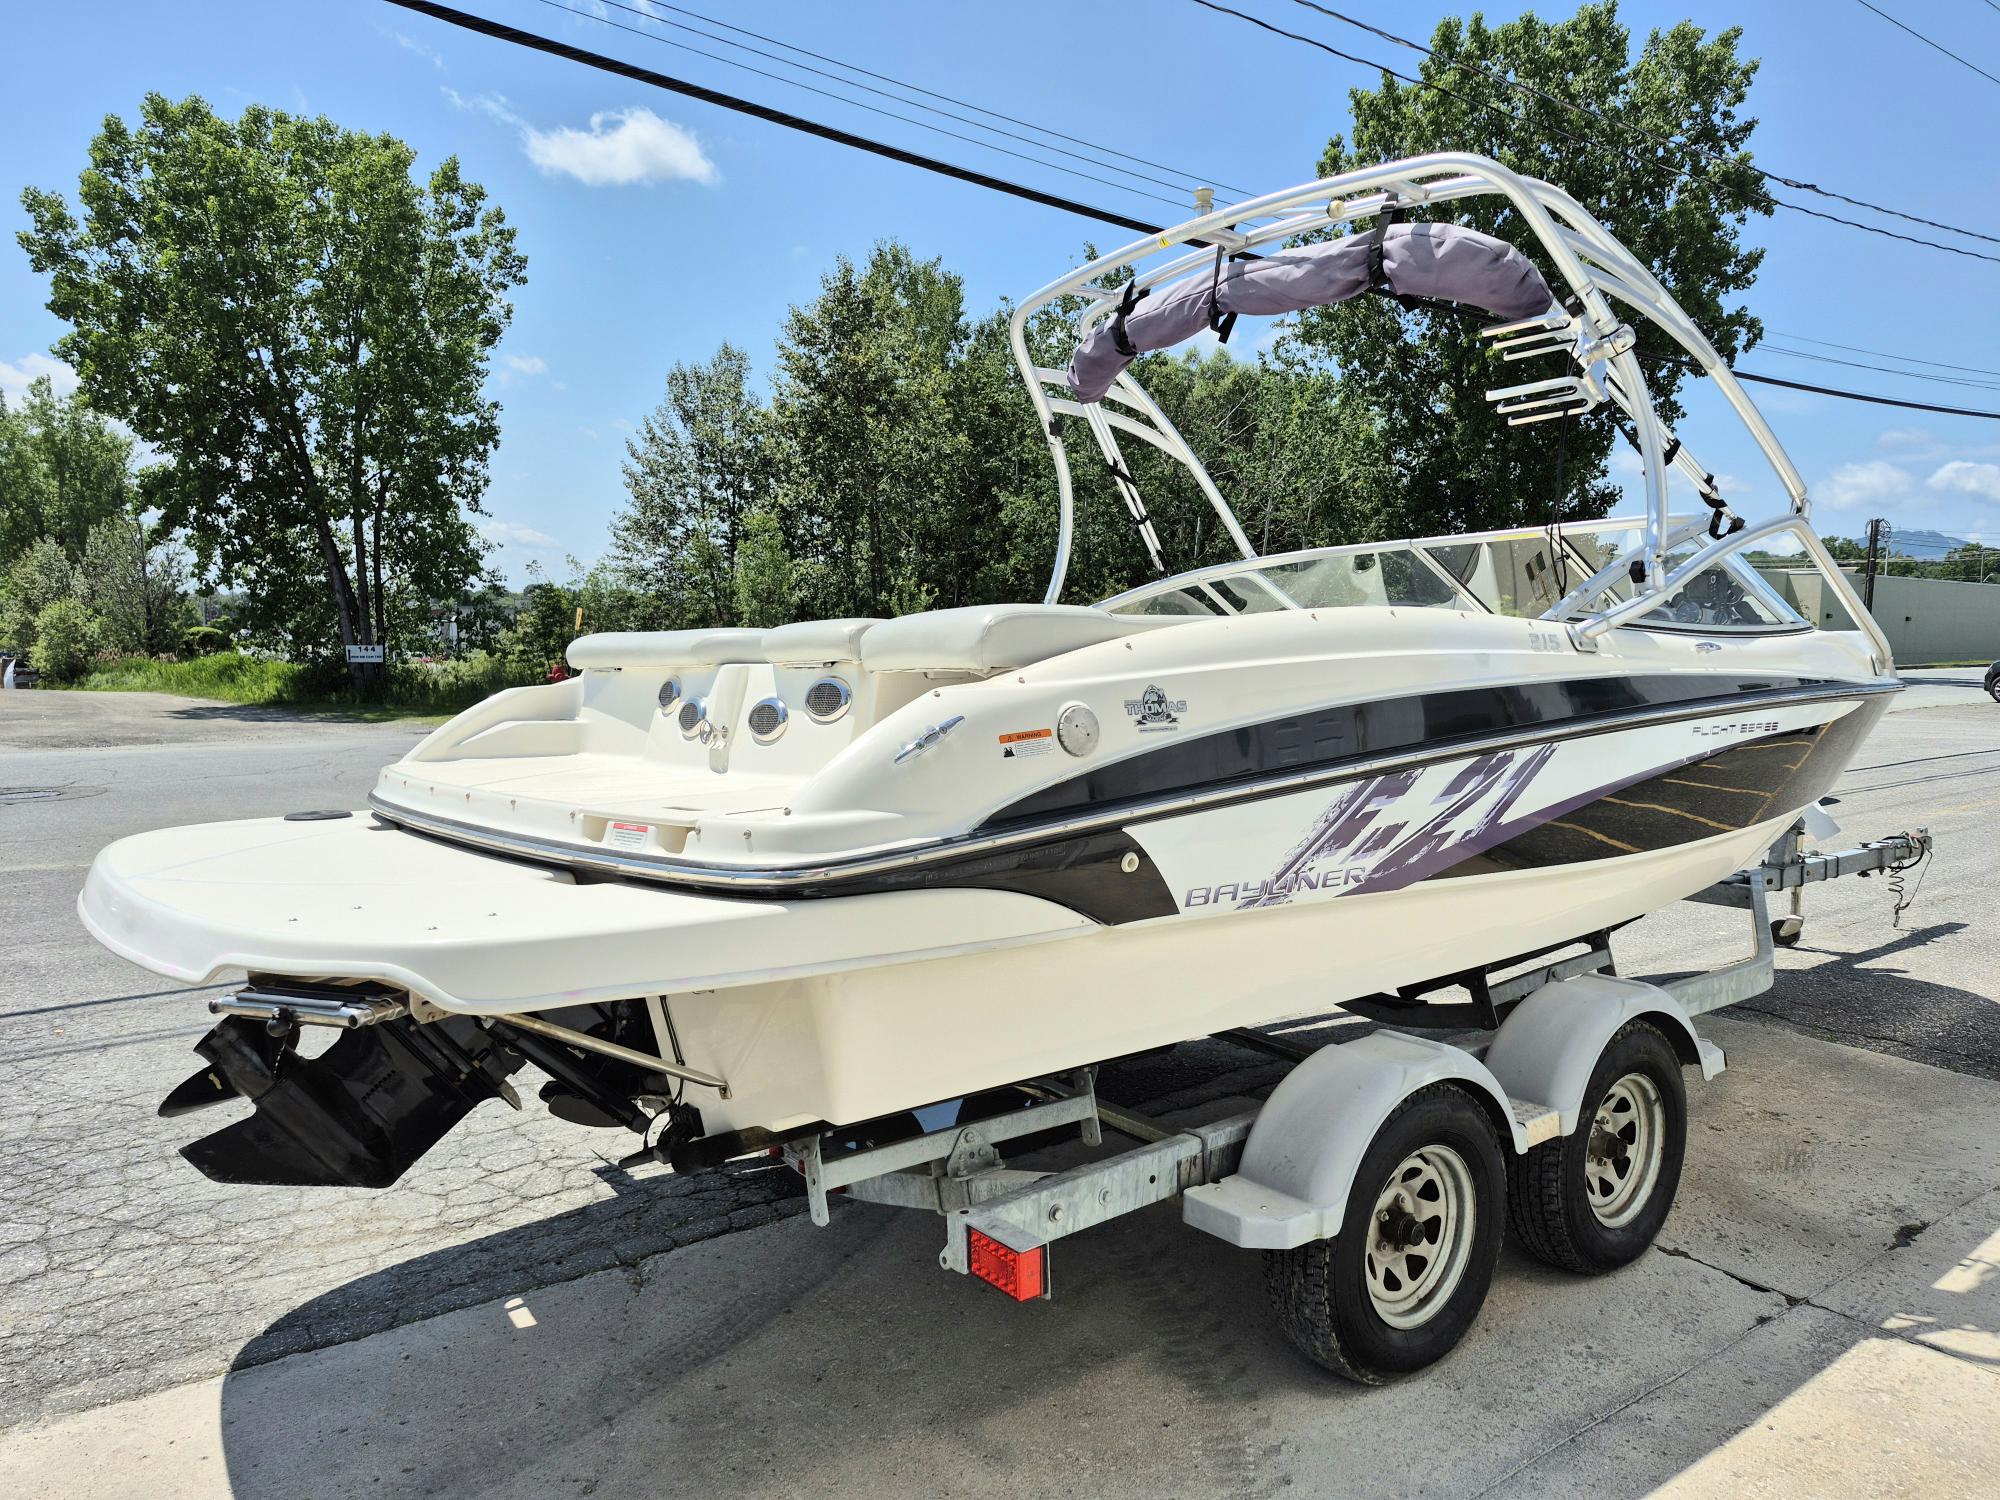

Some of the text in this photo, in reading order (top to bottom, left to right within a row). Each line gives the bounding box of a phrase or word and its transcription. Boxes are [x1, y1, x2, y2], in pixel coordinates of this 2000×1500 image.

[1529, 633, 1561, 650] 215
[1124, 700, 1187, 716] THOMAS
[1016, 731, 1042, 740] WARNING
[1691, 721, 1779, 736] FLIGHT SERIES
[1185, 866, 1367, 908] BAYLINER
